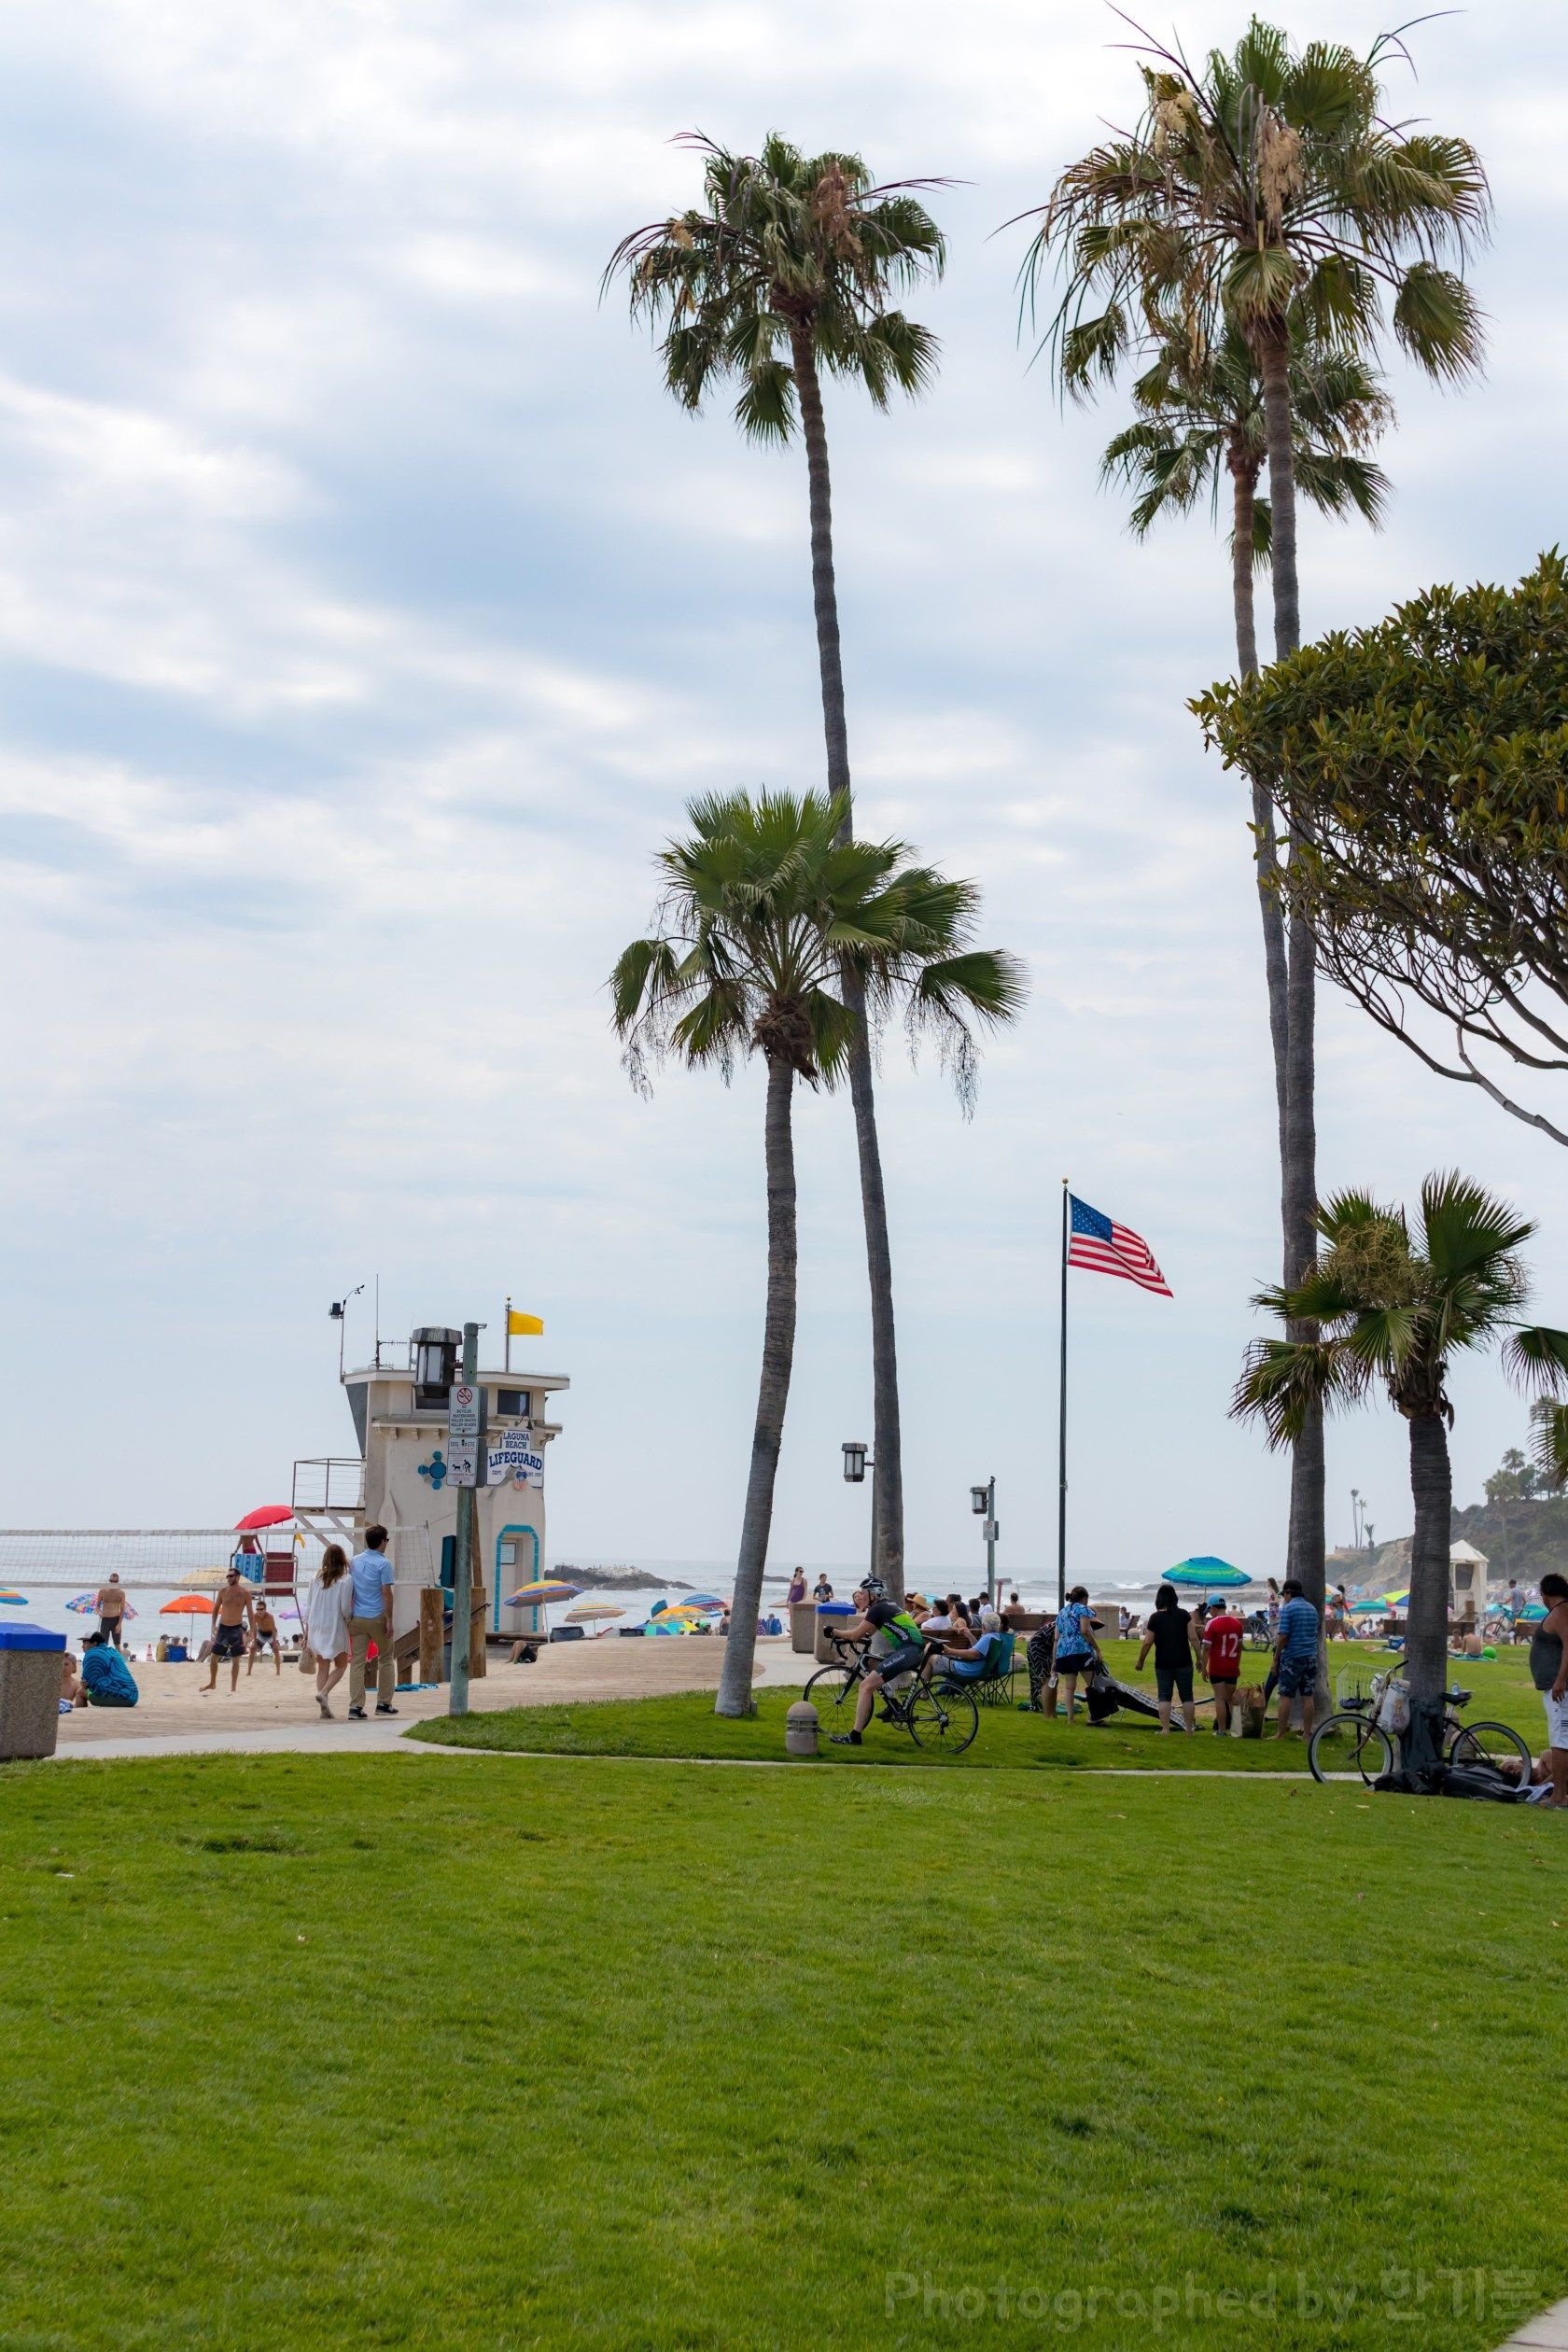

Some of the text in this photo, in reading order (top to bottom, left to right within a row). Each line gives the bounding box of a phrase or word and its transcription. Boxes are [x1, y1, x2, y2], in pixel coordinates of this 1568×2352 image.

[503, 1432, 530, 1441] LAGUNA
[505, 1441, 527, 1449] BEACH
[488, 1451, 542, 1470] LIFEGUARD
[1220, 1633, 1239, 1658] 12
